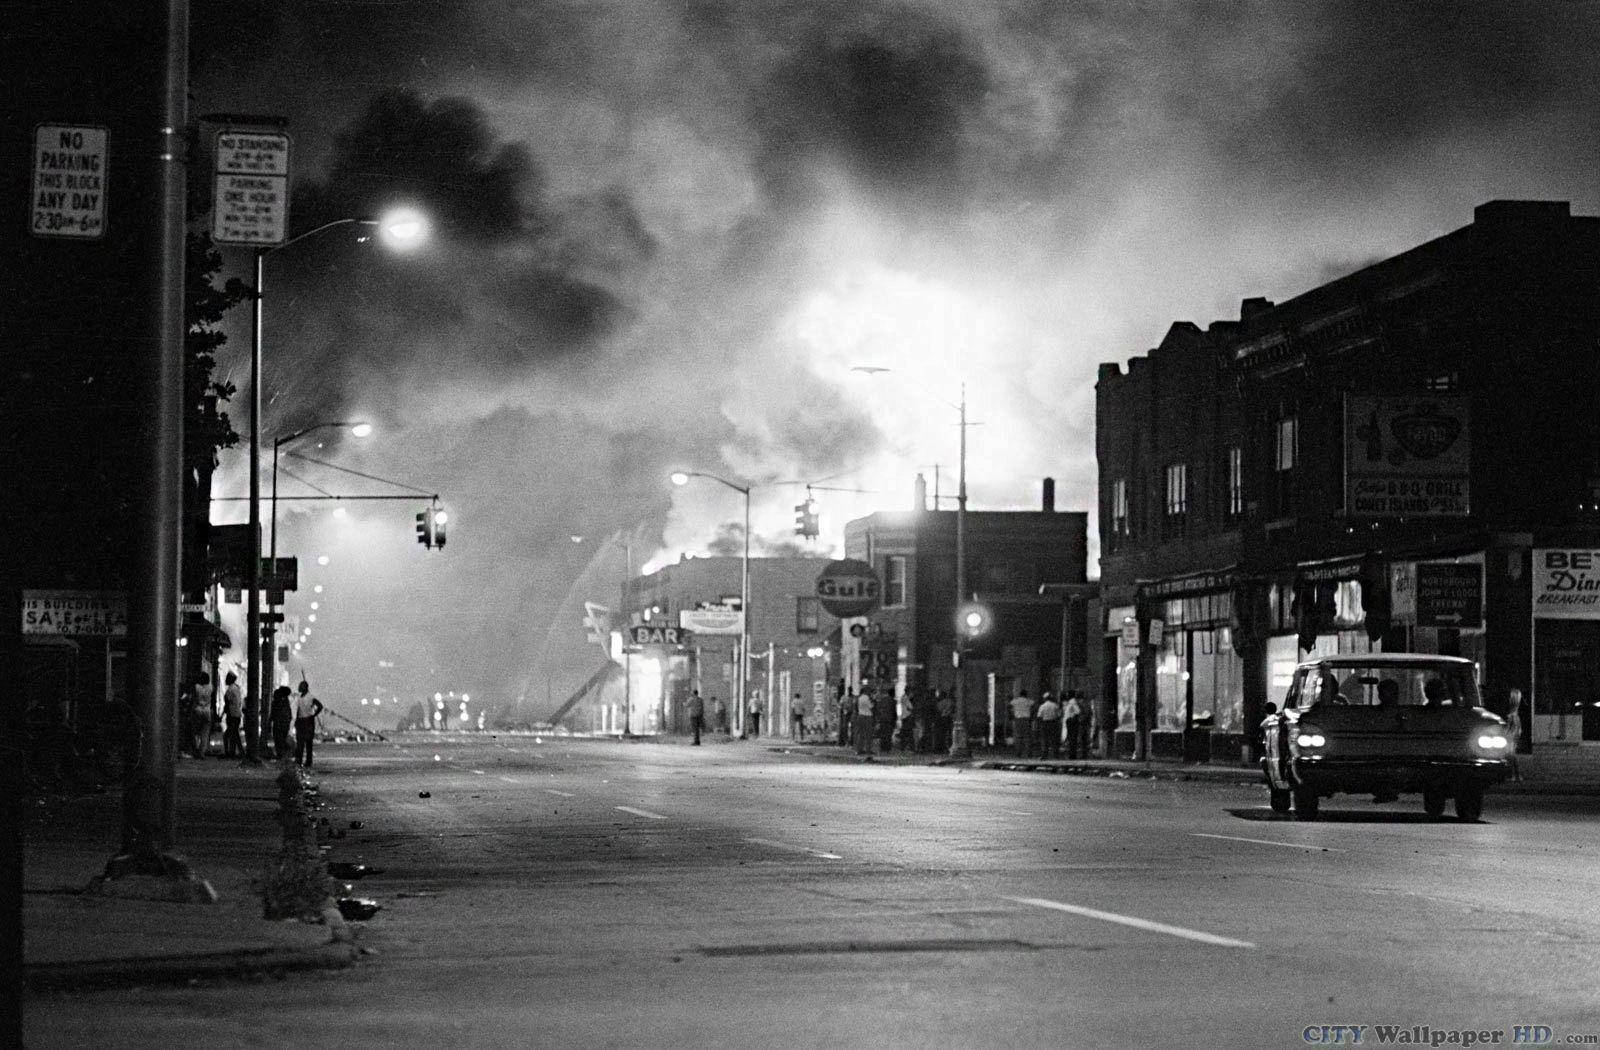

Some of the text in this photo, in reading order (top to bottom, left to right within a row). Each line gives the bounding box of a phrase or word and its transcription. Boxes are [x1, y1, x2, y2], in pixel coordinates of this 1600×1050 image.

[60, 132, 82, 149] NO
[221, 139, 285, 151] NO STANDING
[41, 152, 99, 171] PARKING
[40, 174, 100, 189] THIS BLOCK
[230, 177, 273, 190] PARKING
[38, 191, 98, 210] ANY DAY
[818, 579, 877, 597] Gulf
[1421, 577, 1477, 586] NORTHBOUND
[1420, 589, 1441, 597] JOHN
[1451, 589, 1478, 597] LODGE
[1537, 594, 1599, 604] BREAKFAST
[637, 628, 678, 643] BAR
